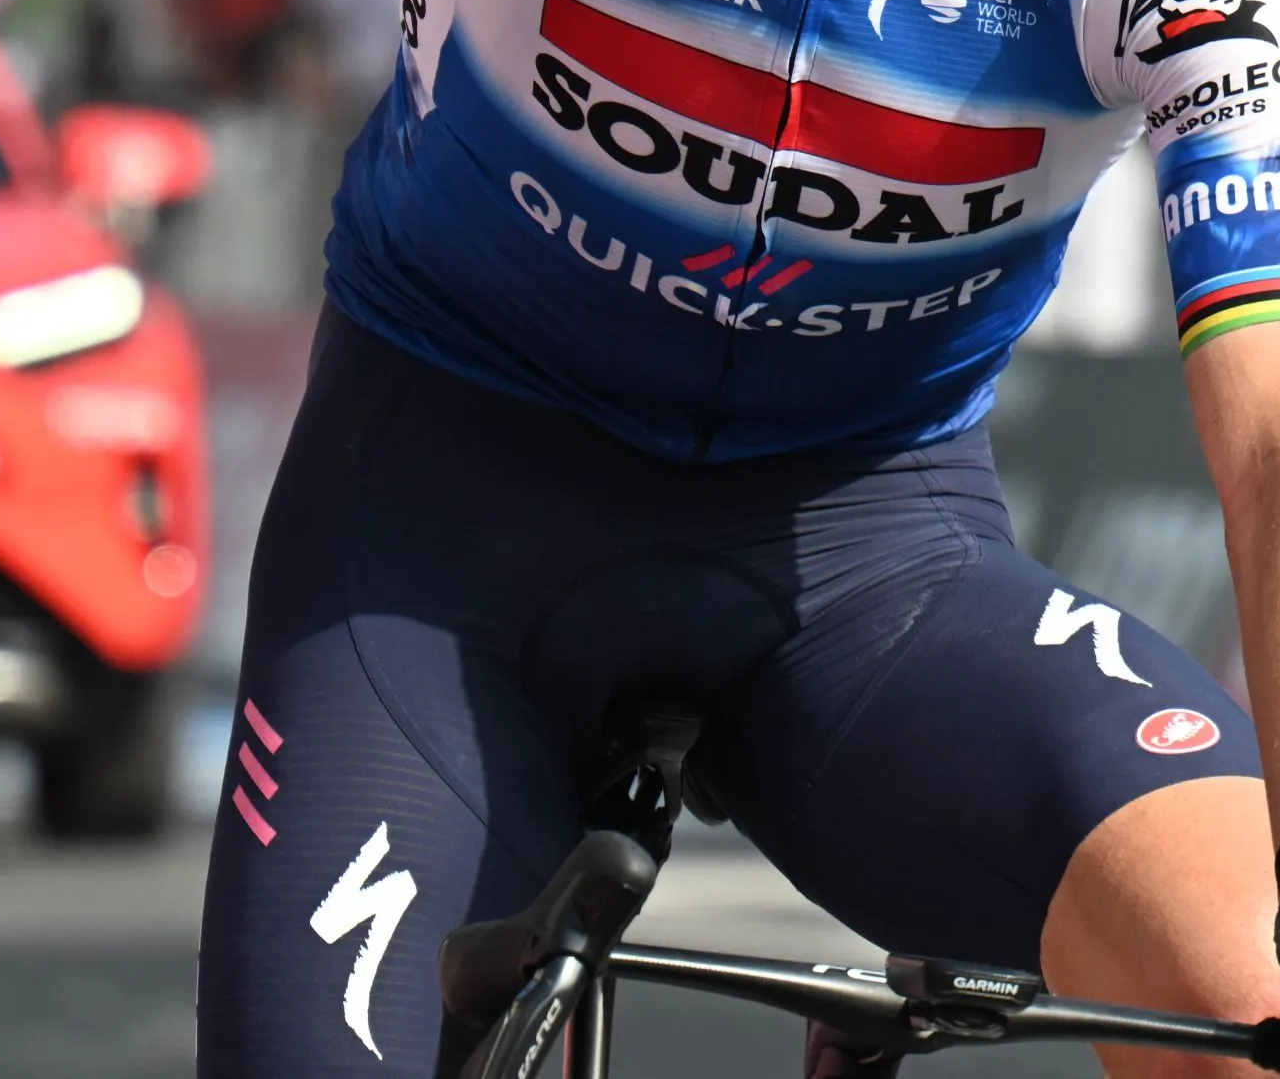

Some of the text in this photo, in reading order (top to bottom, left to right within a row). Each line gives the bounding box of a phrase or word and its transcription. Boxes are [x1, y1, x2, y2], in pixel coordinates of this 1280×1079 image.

[978, 2, 1037, 26] WORLD
[976, 17, 1021, 39] TEAM
[1176, 98, 1266, 135] SPORTS
[532, 52, 1027, 245] SOUDAL
[953, 976, 1019, 996] GARMIN
